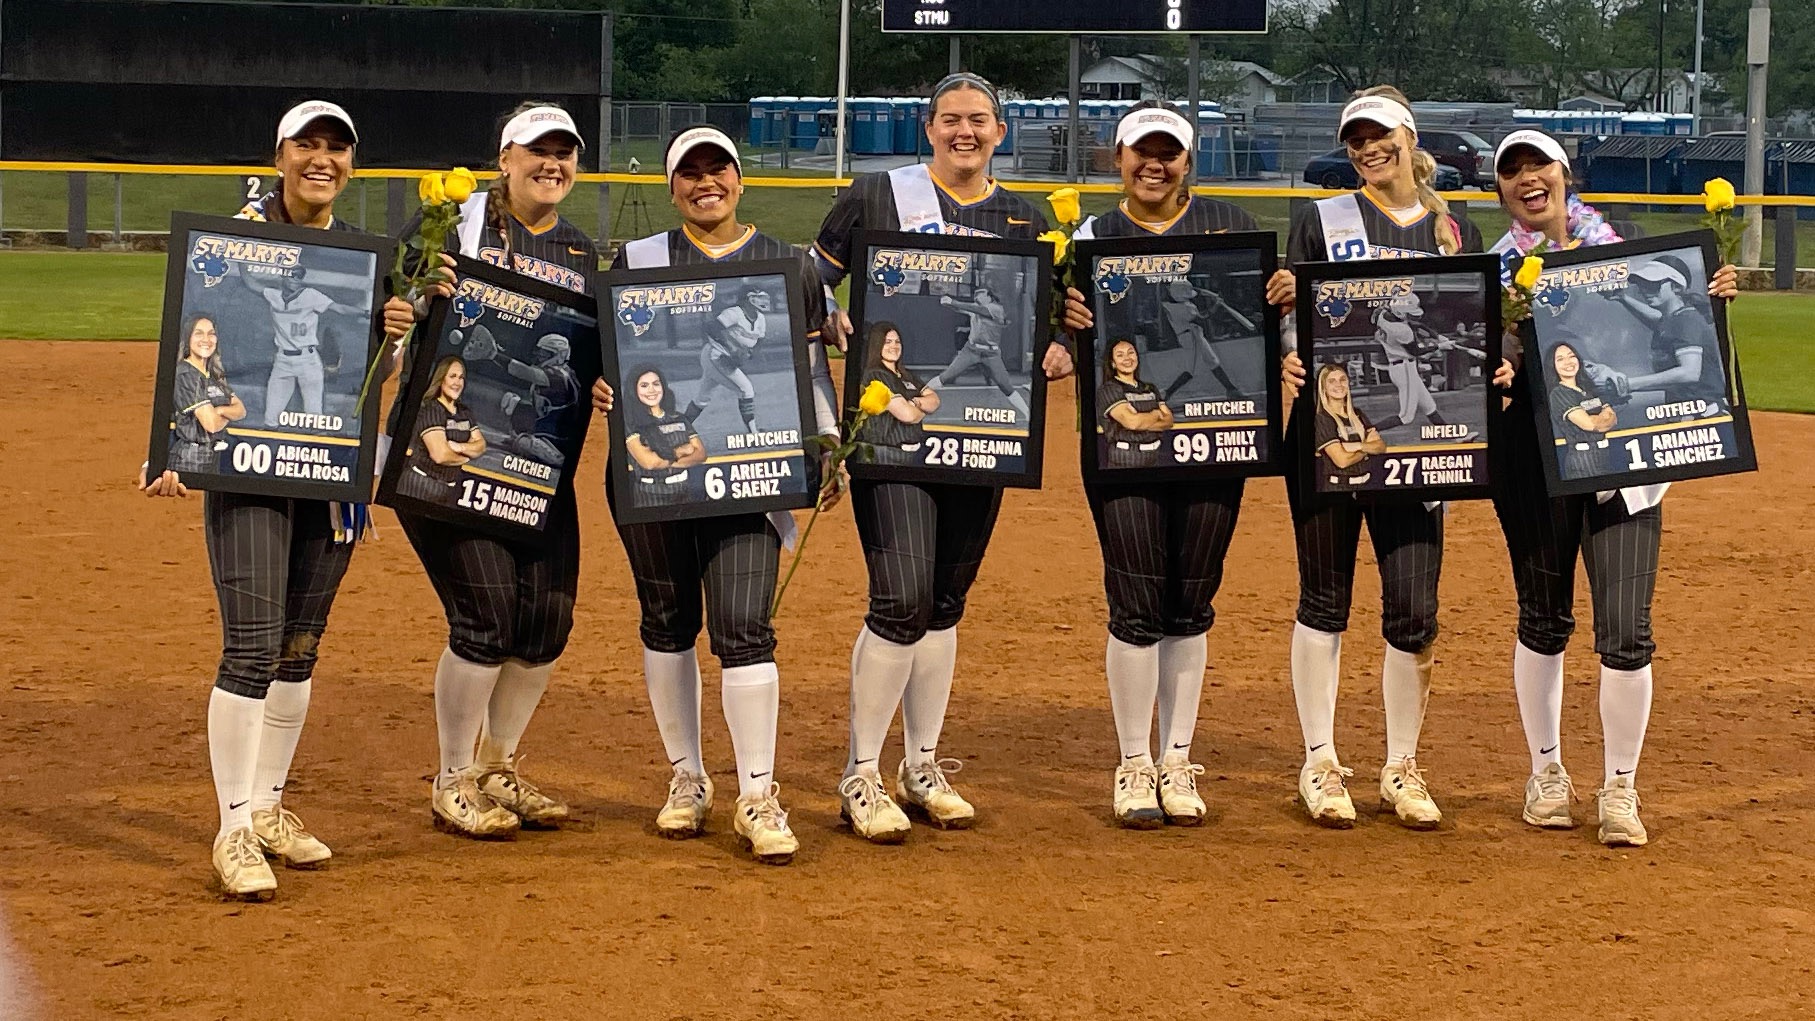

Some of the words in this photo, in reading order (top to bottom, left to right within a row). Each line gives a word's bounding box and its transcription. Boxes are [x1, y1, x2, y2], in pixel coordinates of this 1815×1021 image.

[914, 9, 950, 25] STMU
[1166, 8, 1181, 30] 0
[247, 176, 261, 199] 2
[223, 241, 299, 266] MARY'S
[901, 253, 967, 273] MARY'S
[247, 264, 293, 277] SOFTBALL
[514, 254, 584, 293] MARY'S
[1123, 255, 1191, 274] MARY'S
[1562, 261, 1628, 287] MARY'S
[921, 273, 963, 283] SOFTBALL
[1146, 275, 1188, 284] SOFTBALL
[1586, 281, 1629, 294] SOFTBALL
[646, 284, 714, 306] MARY'S
[1345, 280, 1412, 298] MARY'S
[481, 286, 541, 319] MARY'S
[670, 305, 713, 315] SOFTBALL
[496, 311, 534, 328] SOFTBALL
[964, 406, 1016, 424] PITCHER
[1184, 402, 1202, 417] RH
[1203, 400, 1256, 416] PITCHER
[1646, 399, 1707, 420] OUTFIELD
[279, 411, 343, 431] OUTFIELD
[727, 435, 745, 449] RH
[746, 430, 799, 448] PITCHER
[1215, 430, 1256, 447] EMILY
[1421, 424, 1468, 439] INFIELD
[1652, 427, 1721, 451] ARIANNA
[276, 444, 332, 464] ABIGAIL
[924, 436, 959, 466] 28
[962, 438, 1022, 456] BREANNA
[1173, 433, 1210, 463] 99
[1215, 445, 1259, 462] AYALA
[1624, 438, 1648, 471] 1
[1653, 443, 1726, 468] SANCHEZ
[232, 442, 272, 474] 00
[503, 455, 552, 480] CATCHER
[961, 454, 997, 469] FORD
[1421, 454, 1473, 470] RAEGAN
[312, 464, 350, 482] ROSA
[730, 460, 792, 482] ARIELLA
[1383, 457, 1418, 486] 27
[1421, 469, 1474, 485] TENNILL
[704, 467, 726, 500] 6
[731, 478, 781, 499] SAENZ
[457, 479, 492, 511] 15
[493, 485, 548, 513] MADISON
[489, 500, 539, 526] MAGARO
